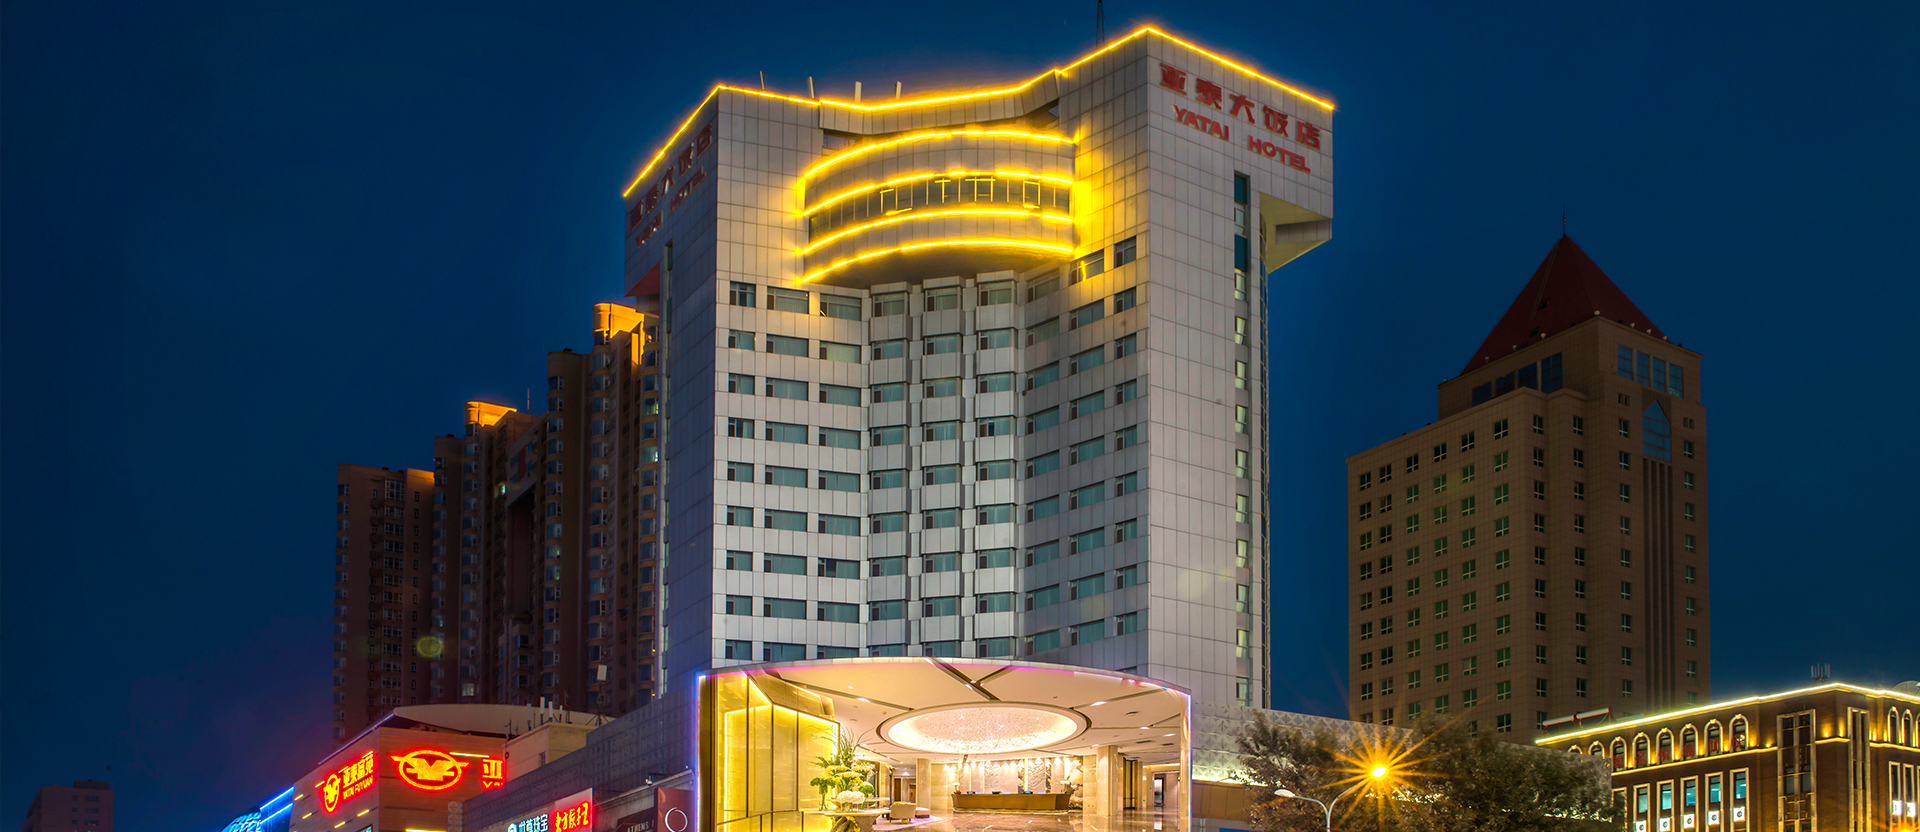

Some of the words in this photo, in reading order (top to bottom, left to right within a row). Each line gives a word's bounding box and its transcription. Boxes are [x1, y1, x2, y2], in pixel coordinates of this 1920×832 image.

[1159, 62, 1321, 150] 亚泰大饭店
[1172, 104, 1230, 141] YATAI
[1248, 135, 1311, 173] HOTEL
[670, 166, 707, 213] HOTEL
[482, 758, 504, 780] 亚
